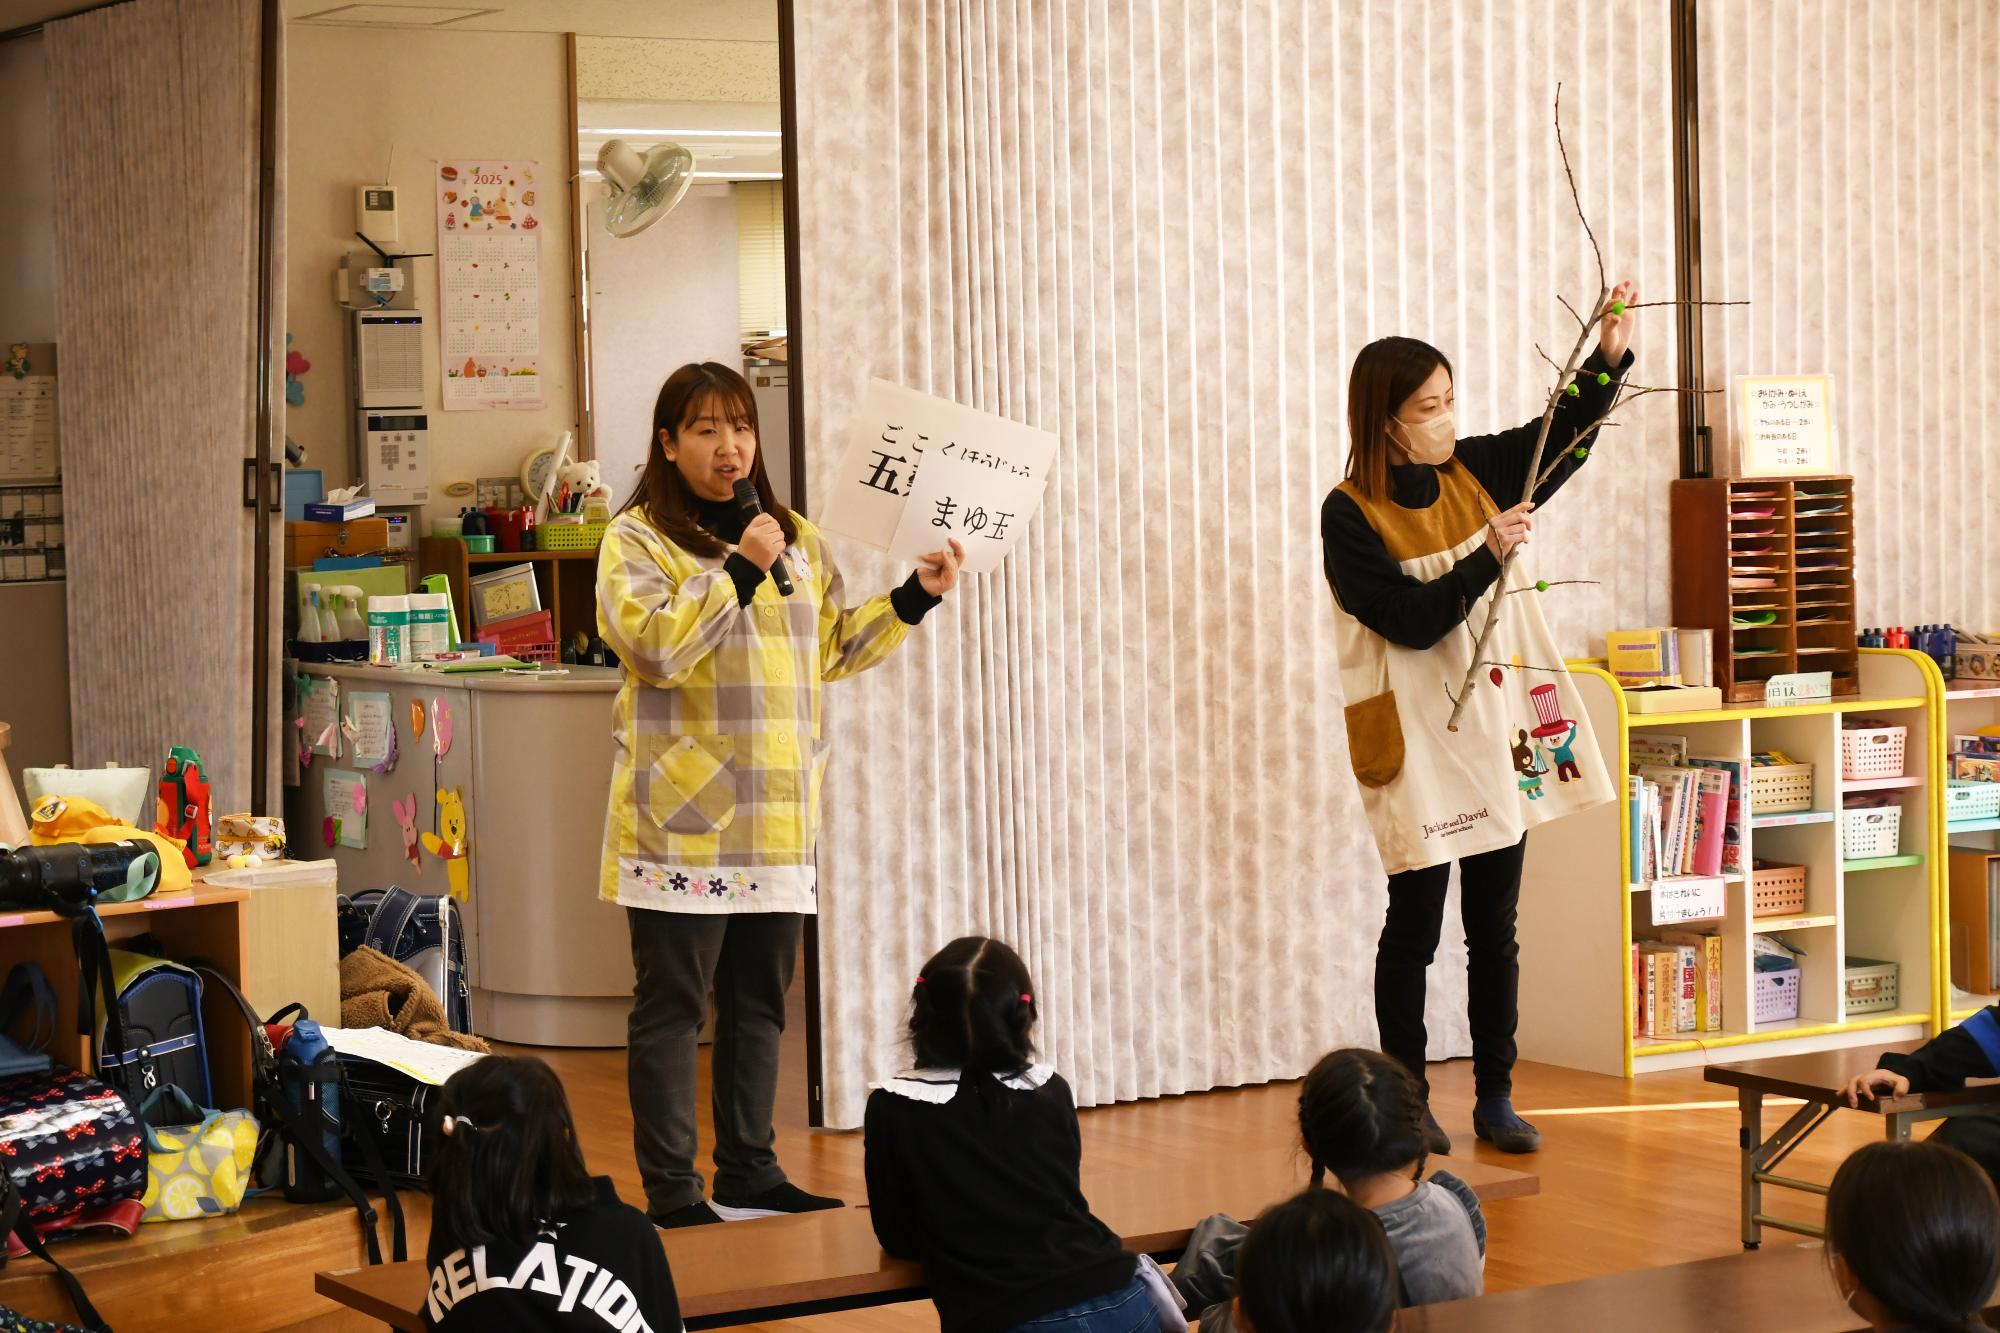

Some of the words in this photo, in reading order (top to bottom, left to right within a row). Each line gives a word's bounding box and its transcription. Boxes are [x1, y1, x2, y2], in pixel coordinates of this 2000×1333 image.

[474, 174, 503, 185] 2025
[931, 496, 1015, 541] まゆ玉
[1422, 822, 1448, 839] Jackie
[1457, 808, 1488, 824] David
